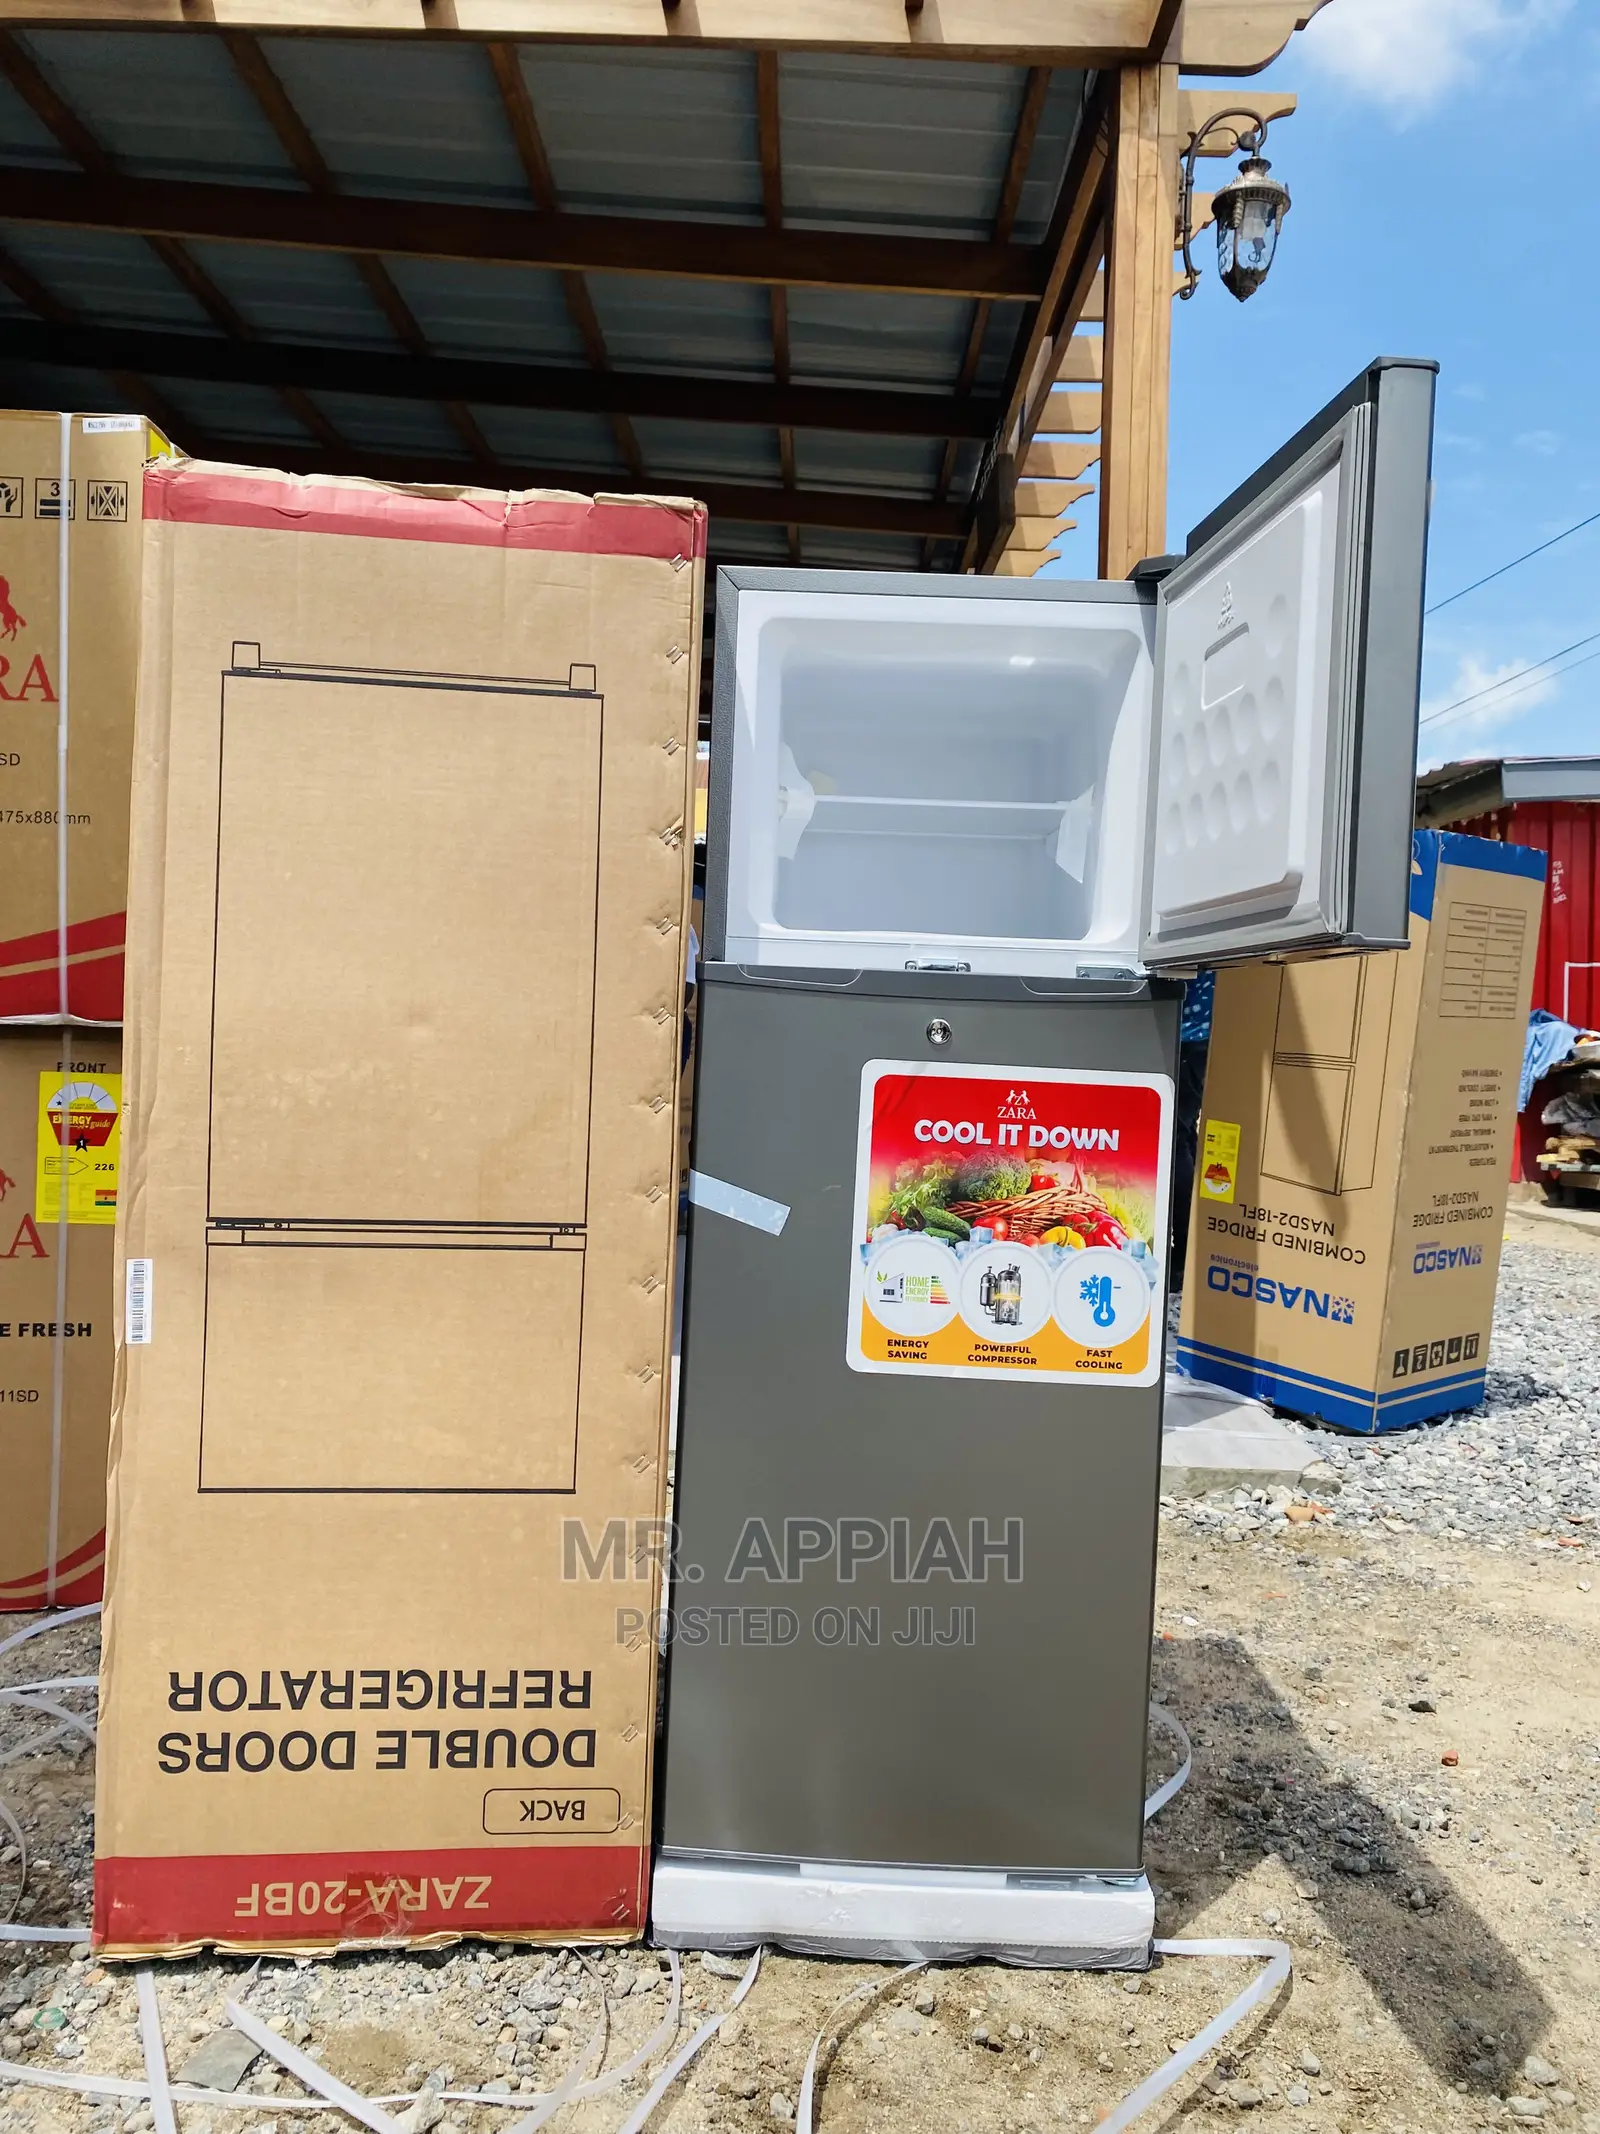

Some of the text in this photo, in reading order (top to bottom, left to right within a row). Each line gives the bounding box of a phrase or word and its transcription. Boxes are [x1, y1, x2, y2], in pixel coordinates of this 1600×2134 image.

[997, 1106, 1037, 1120] ZARA
[90, 1119, 111, 1129] guide
[914, 1119, 1120, 1152] COOL IT DOWN
[94, 1163, 115, 1171] 226
[1239, 1203, 1335, 1236] NASD2-18FL
[1412, 1206, 1494, 1228] COMBINED FRIDGE
[1207, 1216, 1366, 1265] COMBINED FRIDGE
[1413, 1245, 1472, 1274] NASCO
[905, 1276, 930, 1287] HOME
[1207, 1266, 1330, 1318] NASCO
[18, 1322, 92, 1338] FRESH
[887, 1338, 930, 1349] ENERGY
[974, 1343, 1031, 1354] POWERFUL
[887, 1350, 928, 1360] SAVING
[967, 1354, 1038, 1365] COMPRESSOR
[1086, 1349, 1113, 1358] FAST
[1075, 1359, 1123, 1370] COOLING
[168, 1669, 592, 1712] REFRIGERATOR
[158, 1728, 597, 1774] DOUBLE DOORS
[519, 1799, 586, 1822] BACK
[234, 1875, 493, 1918] ZARA-20BF
